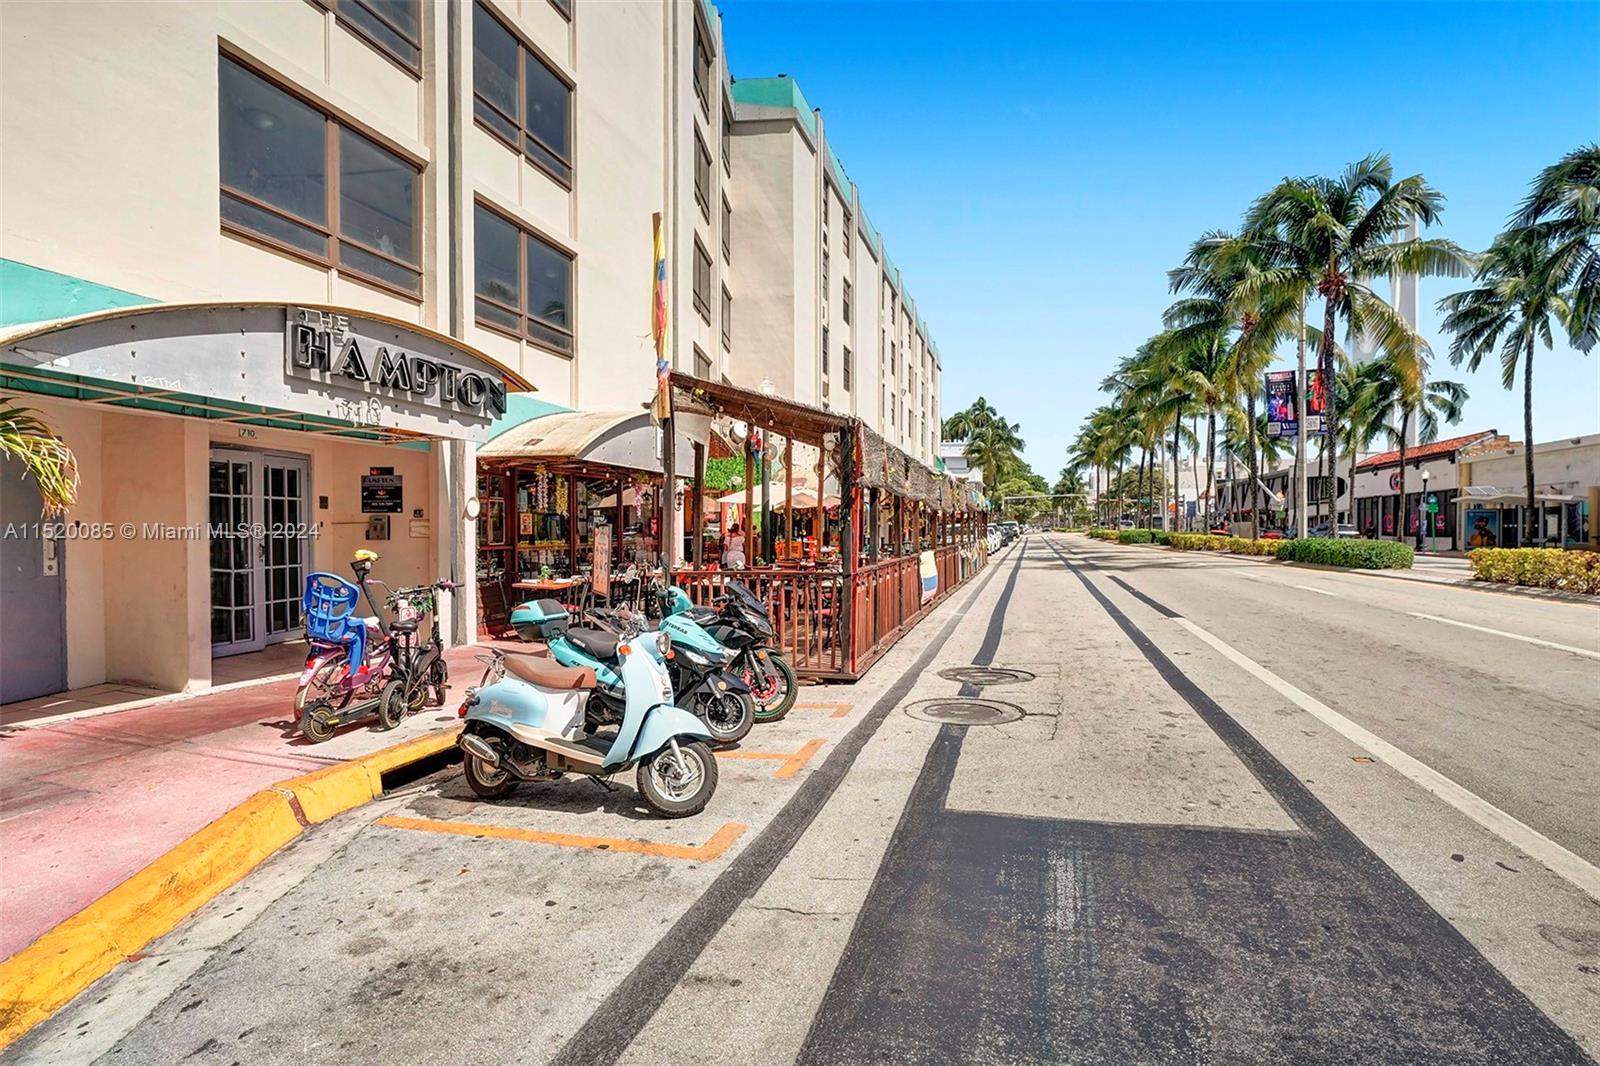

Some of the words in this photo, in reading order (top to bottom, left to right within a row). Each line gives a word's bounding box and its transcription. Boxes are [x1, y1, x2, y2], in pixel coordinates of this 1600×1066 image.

[297, 306, 349, 330] THE
[291, 323, 507, 415] HAMPTON
[241, 428, 256, 438] 710
